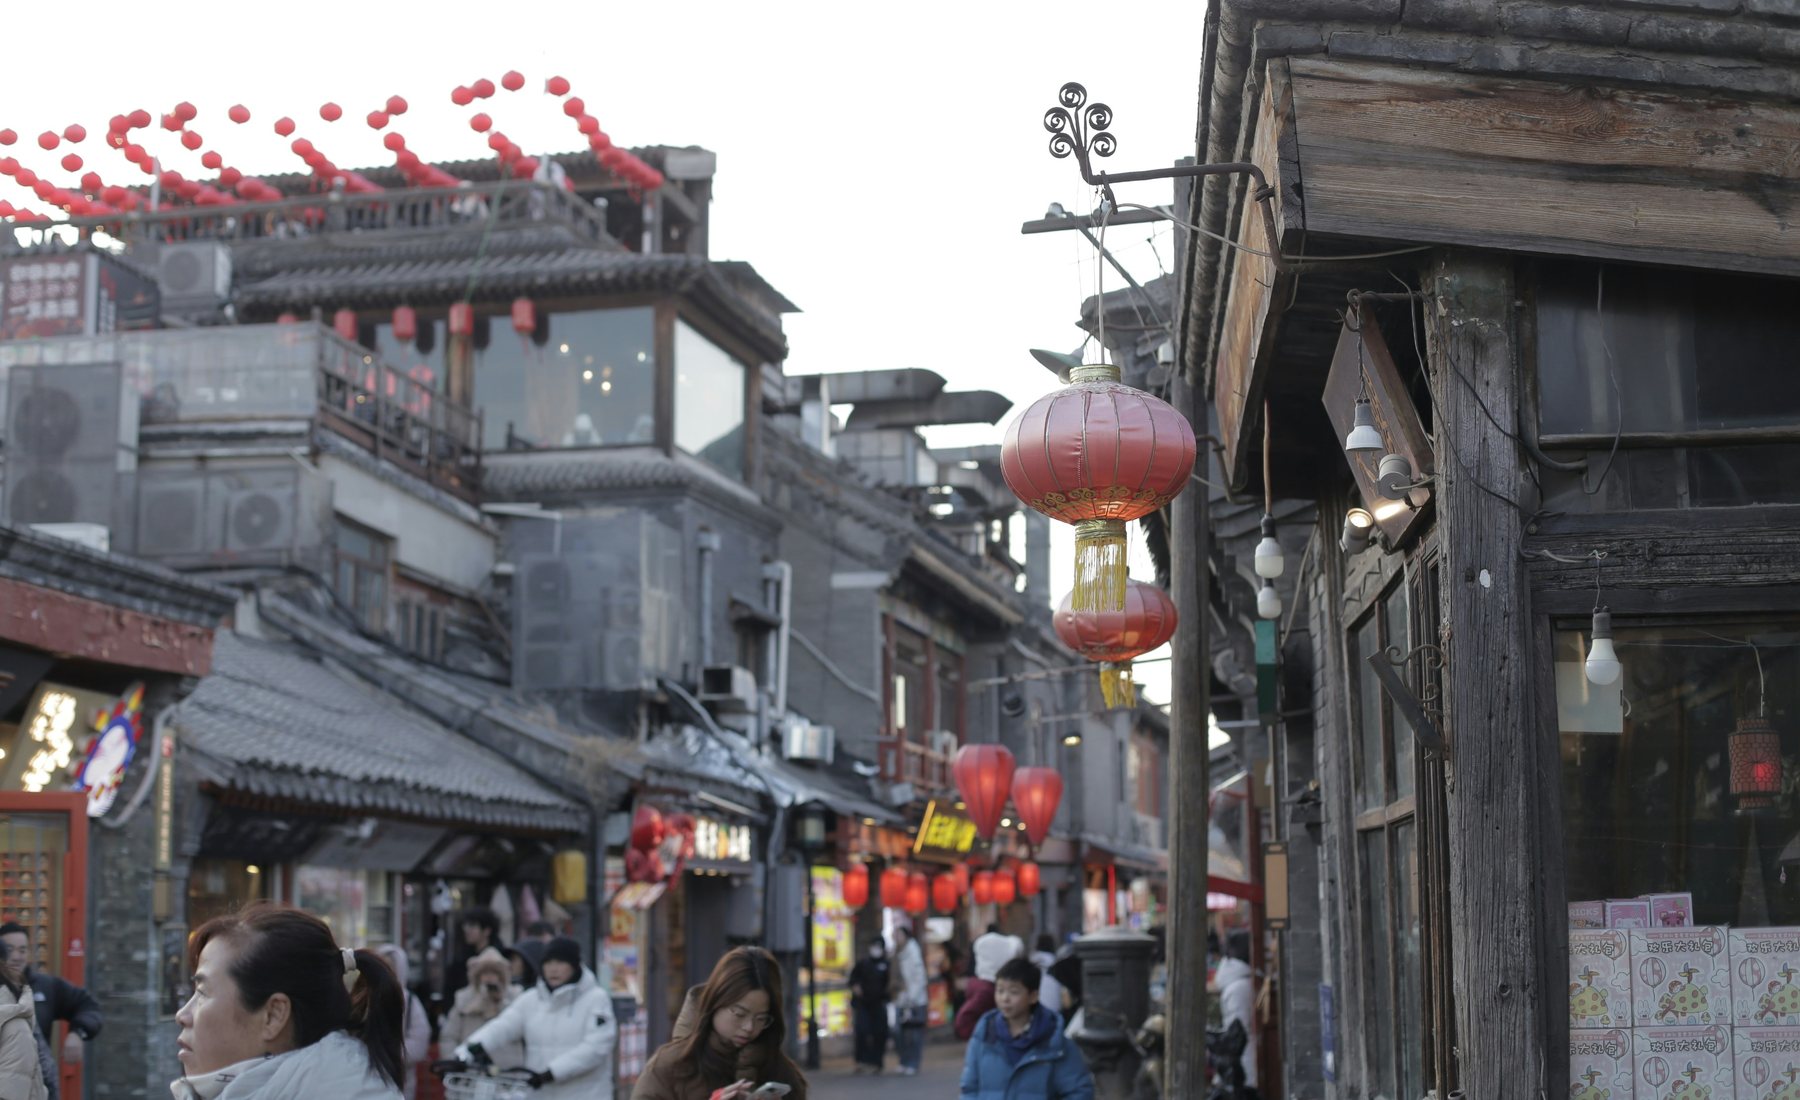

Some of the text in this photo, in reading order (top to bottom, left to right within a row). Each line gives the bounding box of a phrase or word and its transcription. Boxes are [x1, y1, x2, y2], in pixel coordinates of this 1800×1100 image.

[1647, 939, 1714, 953] 欢乐大礼包
[1746, 940, 1800, 954] 欢乐大礼
[1650, 1037, 1717, 1053] 欢乐大礼包
